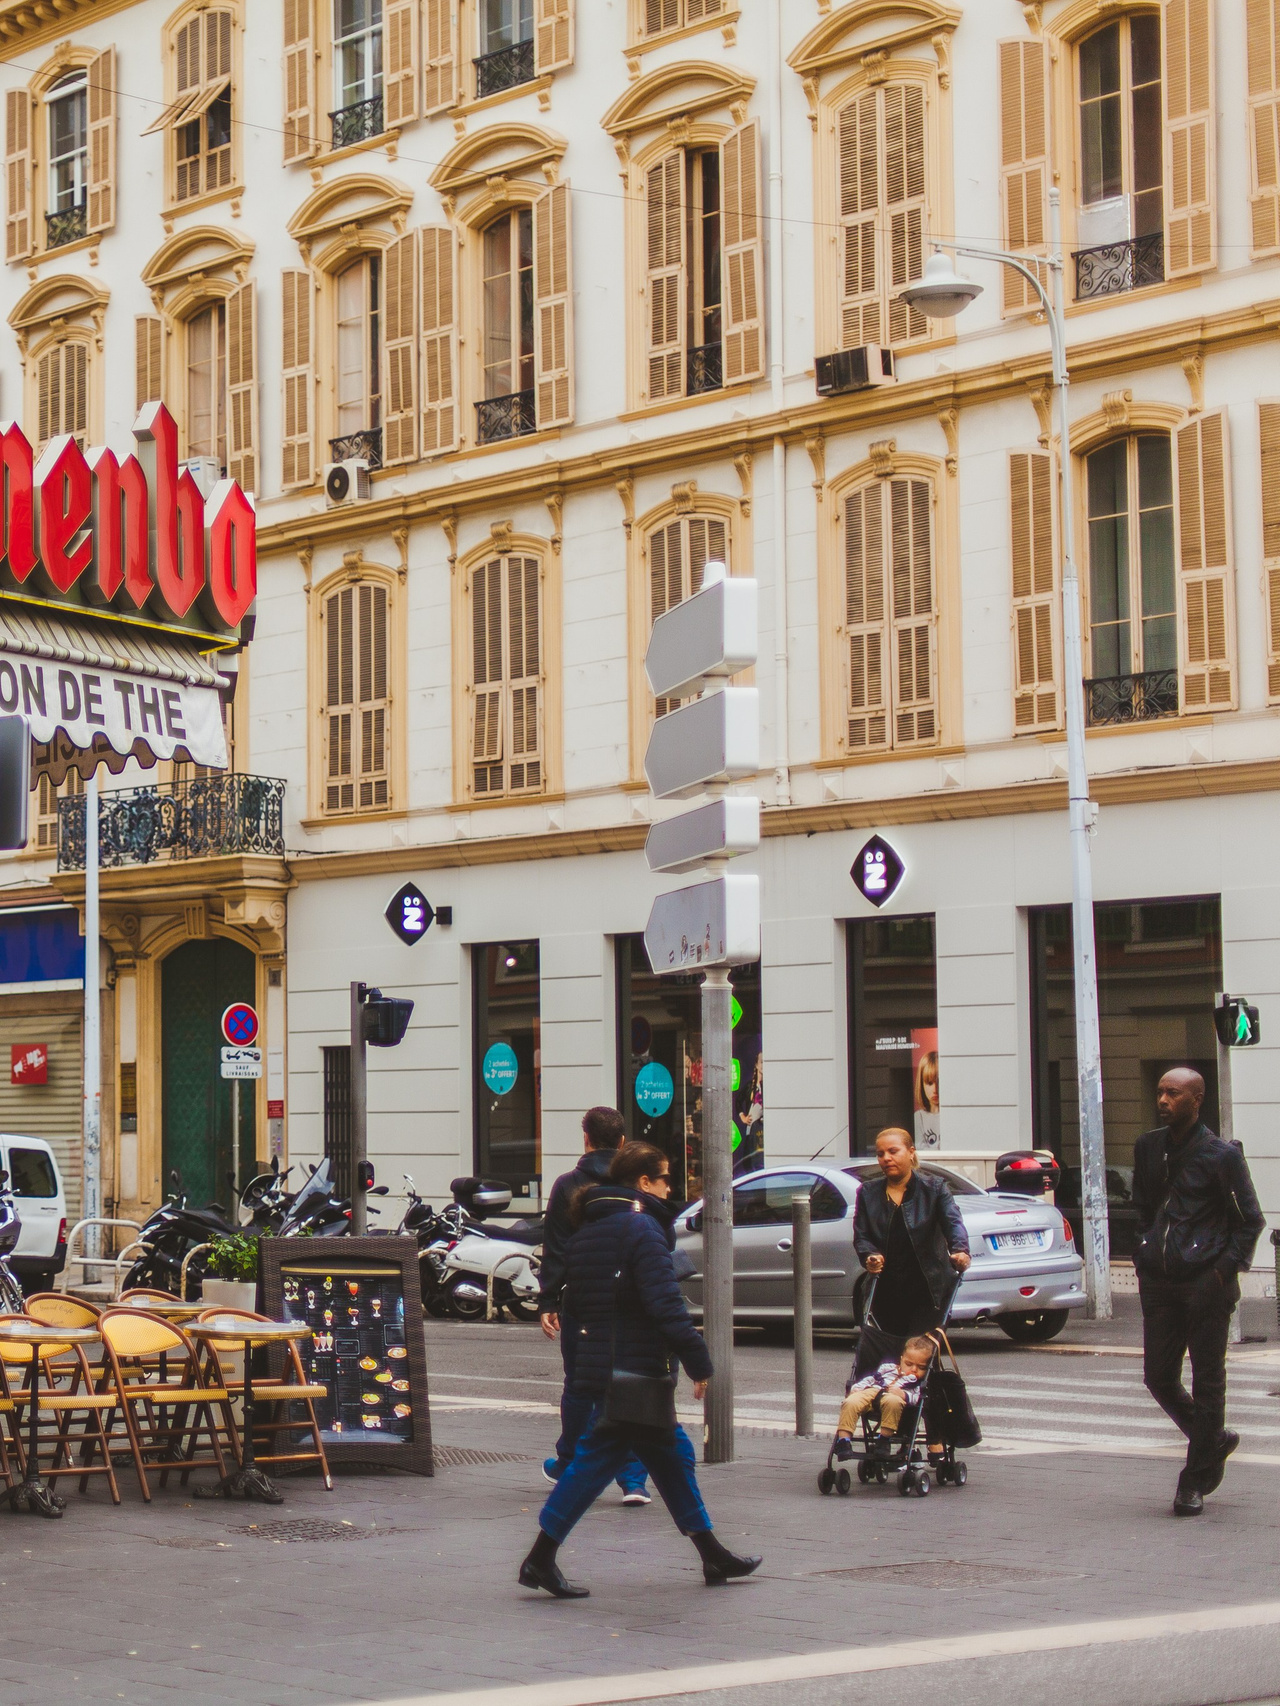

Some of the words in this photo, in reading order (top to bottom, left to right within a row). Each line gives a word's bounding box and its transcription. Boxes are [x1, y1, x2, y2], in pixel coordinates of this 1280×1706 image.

[57, 668, 106, 727] DE
[113, 678, 187, 740] THE
[651, 1092, 670, 1100] OFFERT
